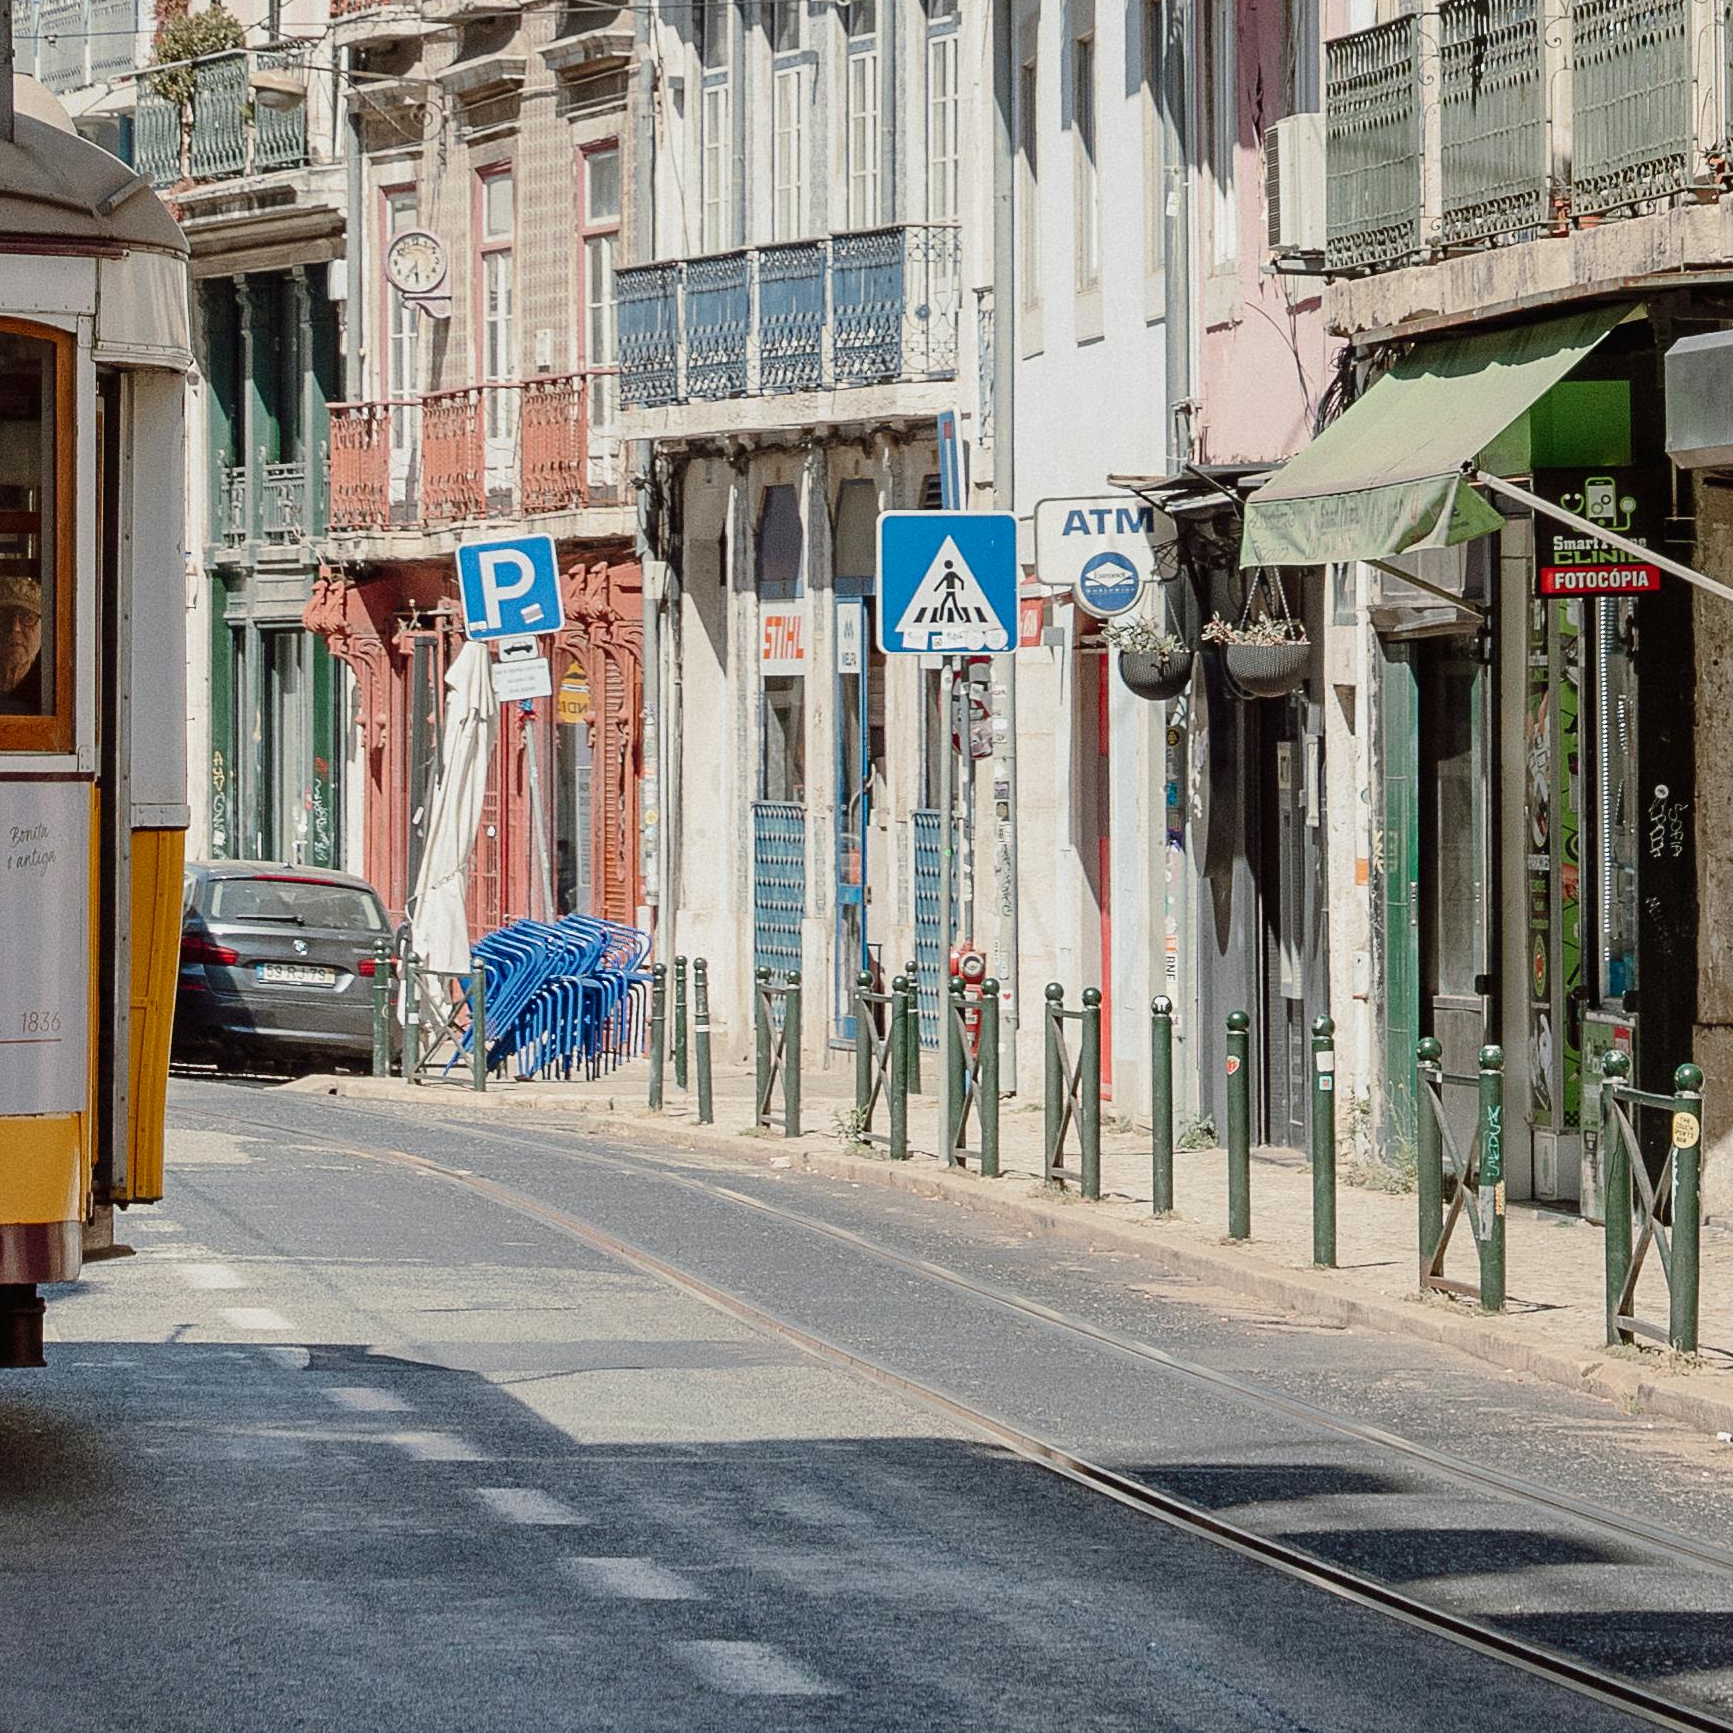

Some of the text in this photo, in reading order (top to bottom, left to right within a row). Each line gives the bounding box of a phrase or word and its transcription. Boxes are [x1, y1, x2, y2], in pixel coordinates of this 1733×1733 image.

[1062, 507, 1155, 536] ATM
[479, 548, 536, 630] P
[1554, 568, 1649, 590] FOTOCÓPIA
[763, 616, 804, 659] STIHL
[9, 822, 50, 848] Bonita
[20, 1011, 62, 1033] 1836
